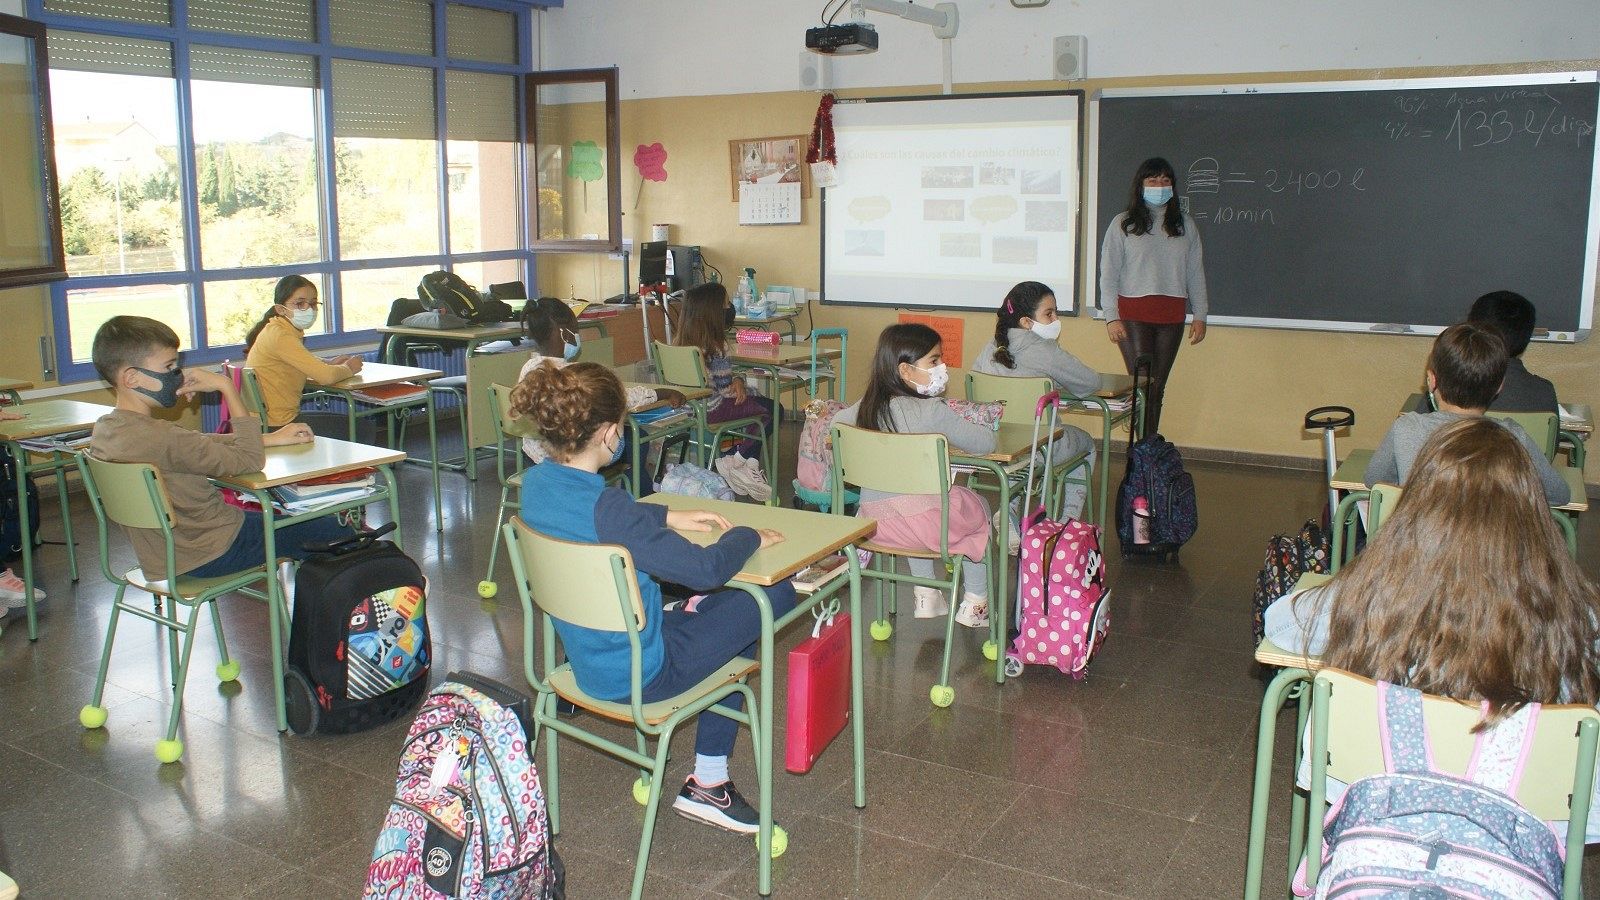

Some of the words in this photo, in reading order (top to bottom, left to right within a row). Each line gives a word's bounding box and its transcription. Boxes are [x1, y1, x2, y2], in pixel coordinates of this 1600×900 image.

[1445, 109, 1514, 151] 133
[880, 150, 897, 160] son
[914, 149, 948, 160] causas
[949, 147, 966, 159] del
[967, 147, 1005, 159] cambio
[1264, 168, 1341, 195] 2400
